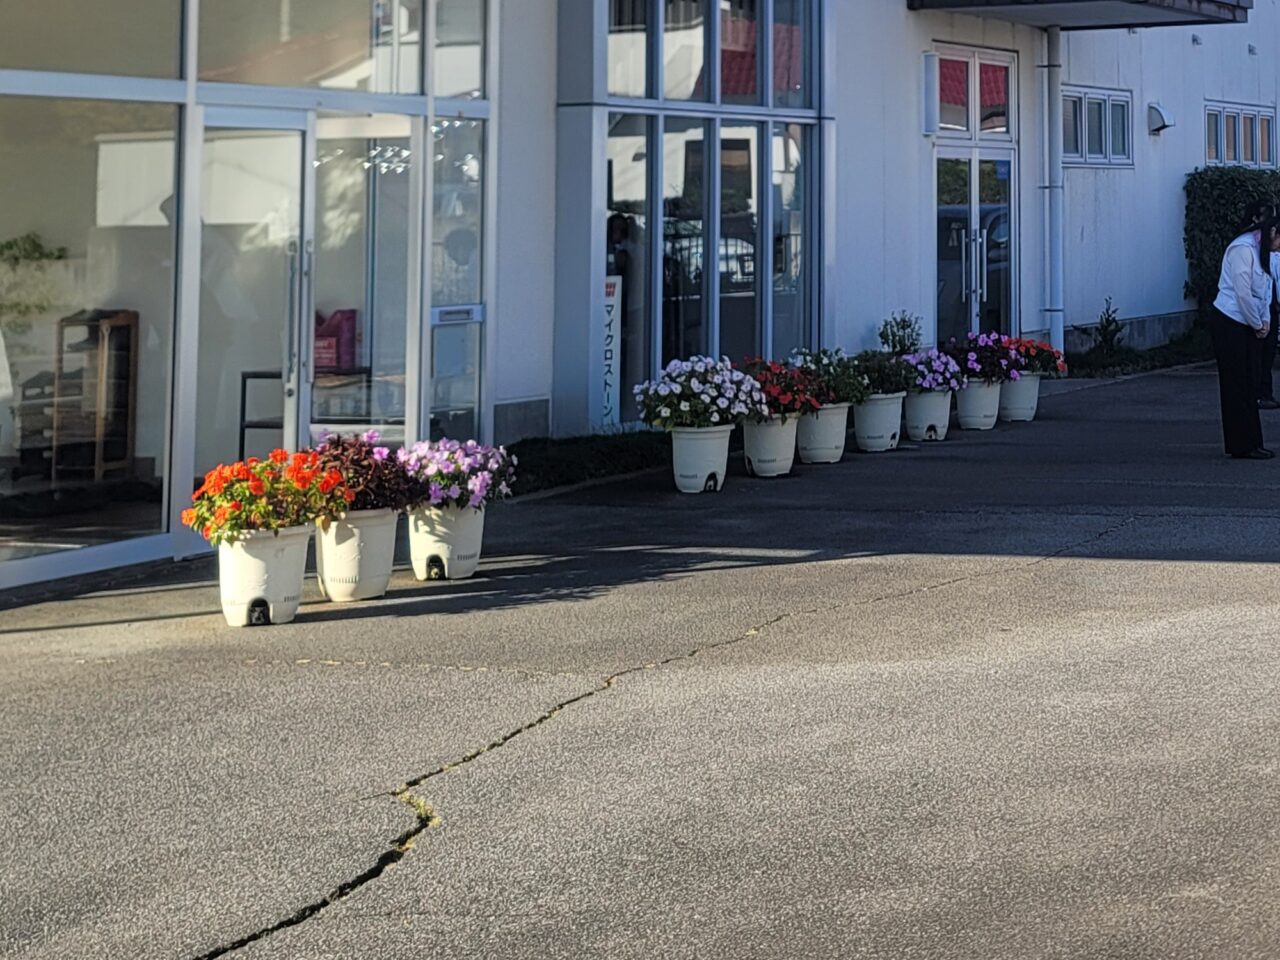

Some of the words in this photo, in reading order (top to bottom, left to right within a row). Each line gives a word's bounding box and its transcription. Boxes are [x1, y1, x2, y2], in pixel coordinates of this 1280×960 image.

[603, 304, 615, 417] マイクロストーン
